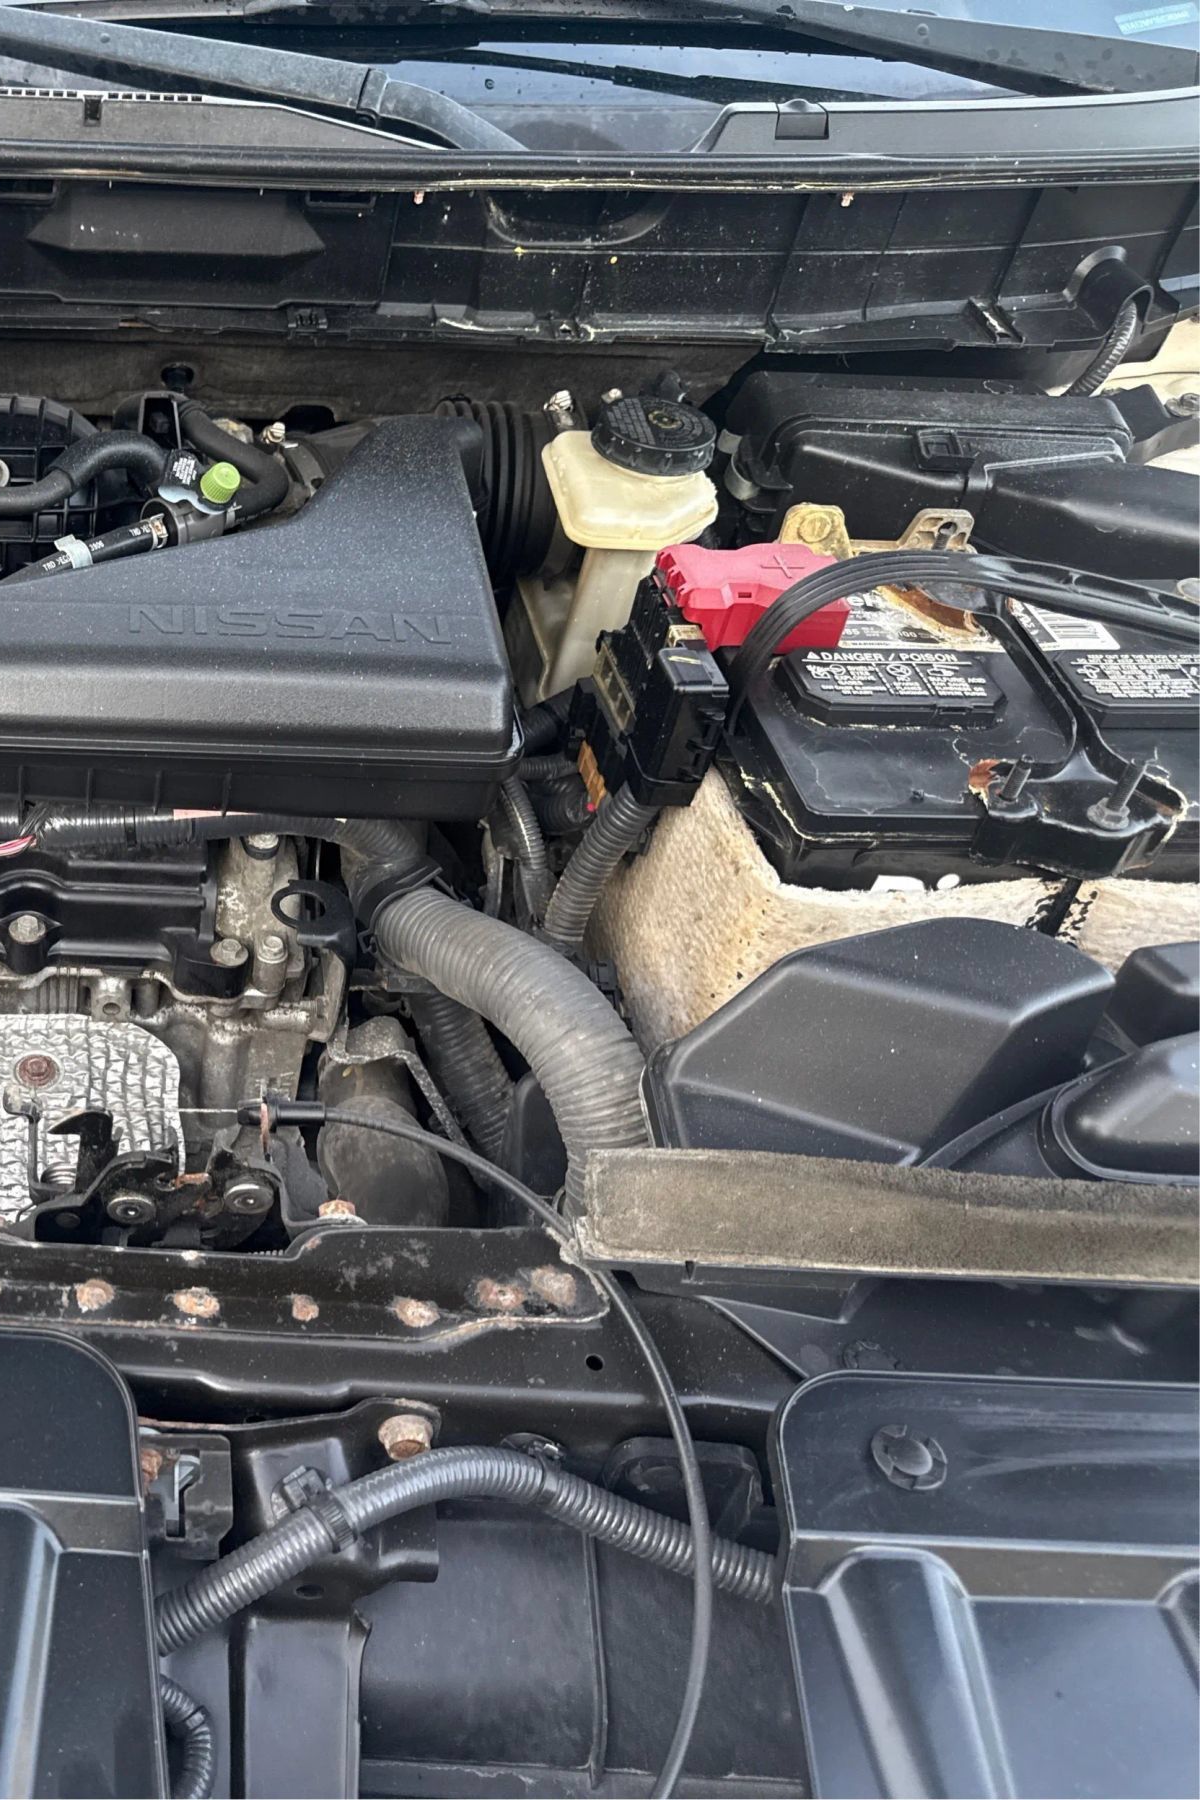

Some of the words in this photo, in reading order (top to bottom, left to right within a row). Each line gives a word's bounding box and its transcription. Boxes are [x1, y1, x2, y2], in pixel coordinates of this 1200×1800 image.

[128, 604, 453, 645] NISSAN
[820, 651, 885, 661] DANGER
[888, 652, 895, 661] /
[899, 652, 958, 662] POISON
